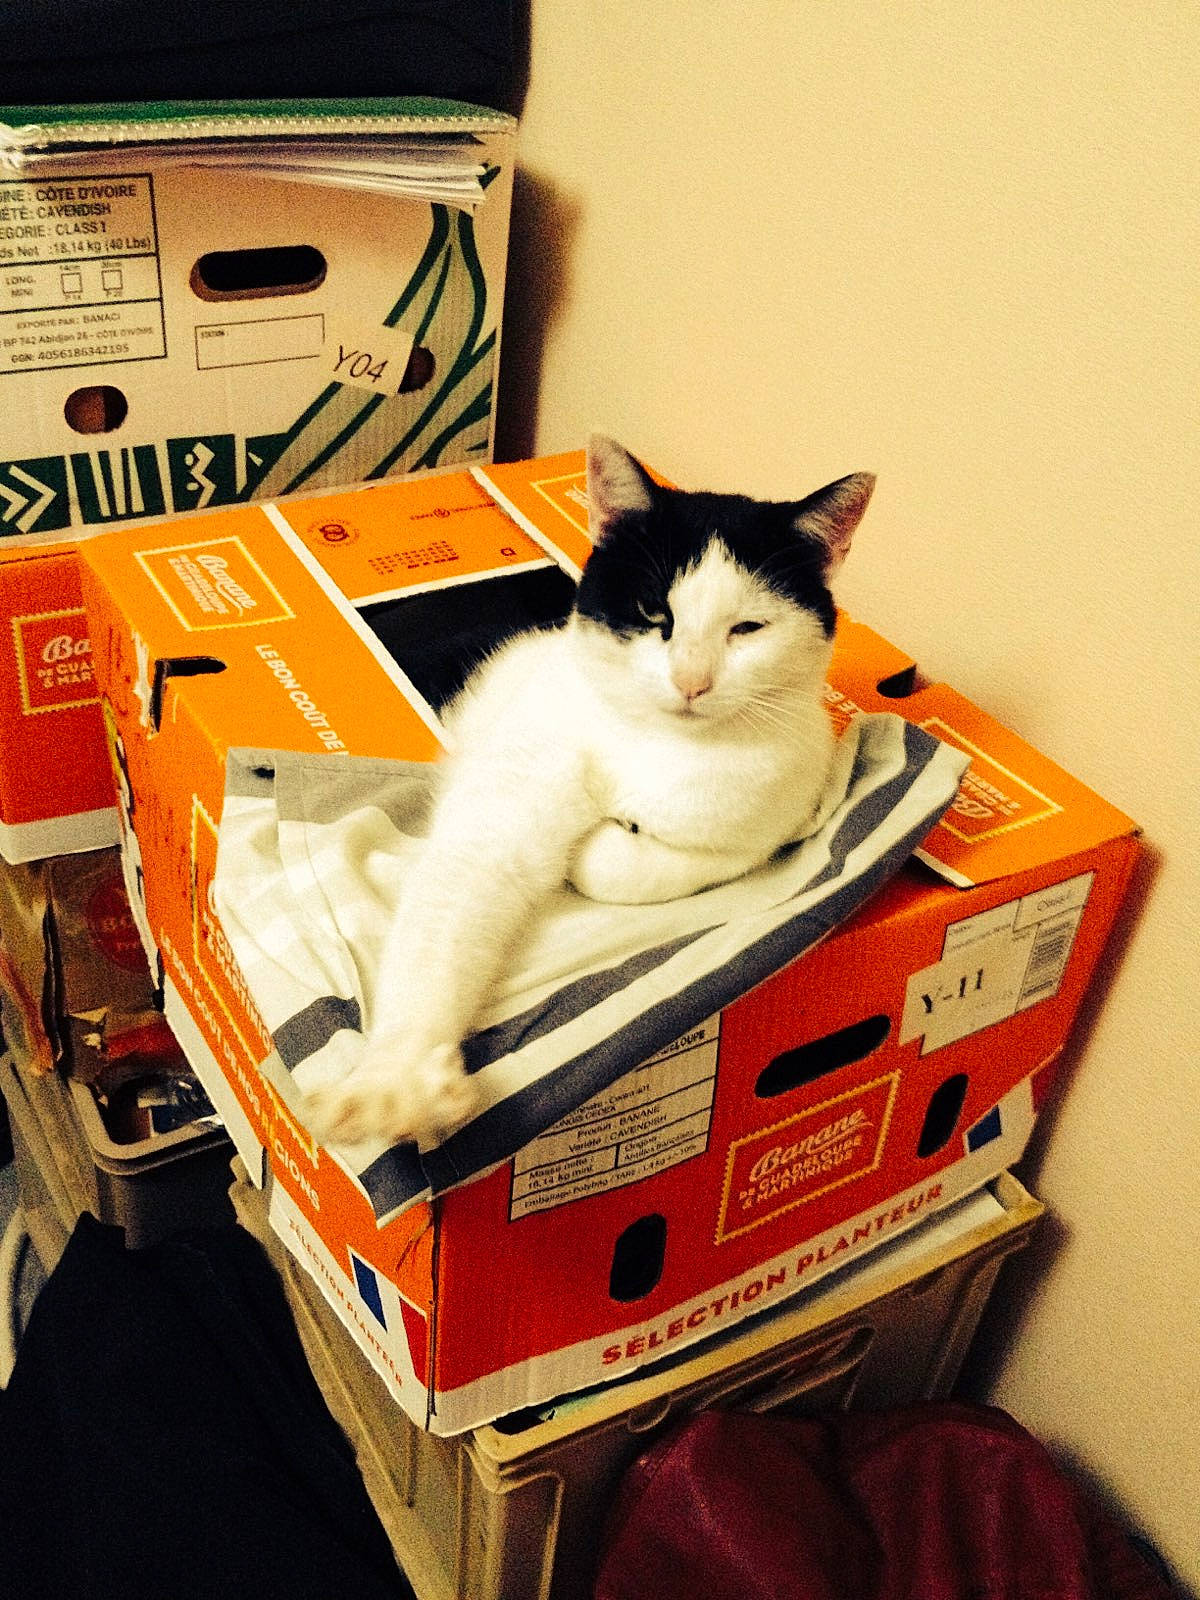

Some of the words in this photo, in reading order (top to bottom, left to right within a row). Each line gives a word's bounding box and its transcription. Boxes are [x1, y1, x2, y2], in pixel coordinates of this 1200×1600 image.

[36, 185, 75, 201] CÔTE
[78, 184, 137, 200] D'IVOIRE
[37, 203, 112, 219] CAVENDISH
[56, 221, 98, 236] CLASS
[88, 240, 102, 253] kg
[332, 344, 389, 383] Y04
[255, 644, 279, 660] LE
[266, 660, 302, 689] BON
[289, 690, 331, 728] GOÛT
[317, 730, 346, 751] DE
[610, 1115, 668, 1141] CAVENDISH
[620, 1105, 660, 1126] BANANE
[749, 1108, 874, 1182] Banane
[757, 1149, 853, 1203] MARTINIQUE
[759, 1135, 862, 1191] GUADELOUPE
[601, 1266, 786, 1366] SÉLECTION
[797, 1184, 943, 1275] PLANTEUR
